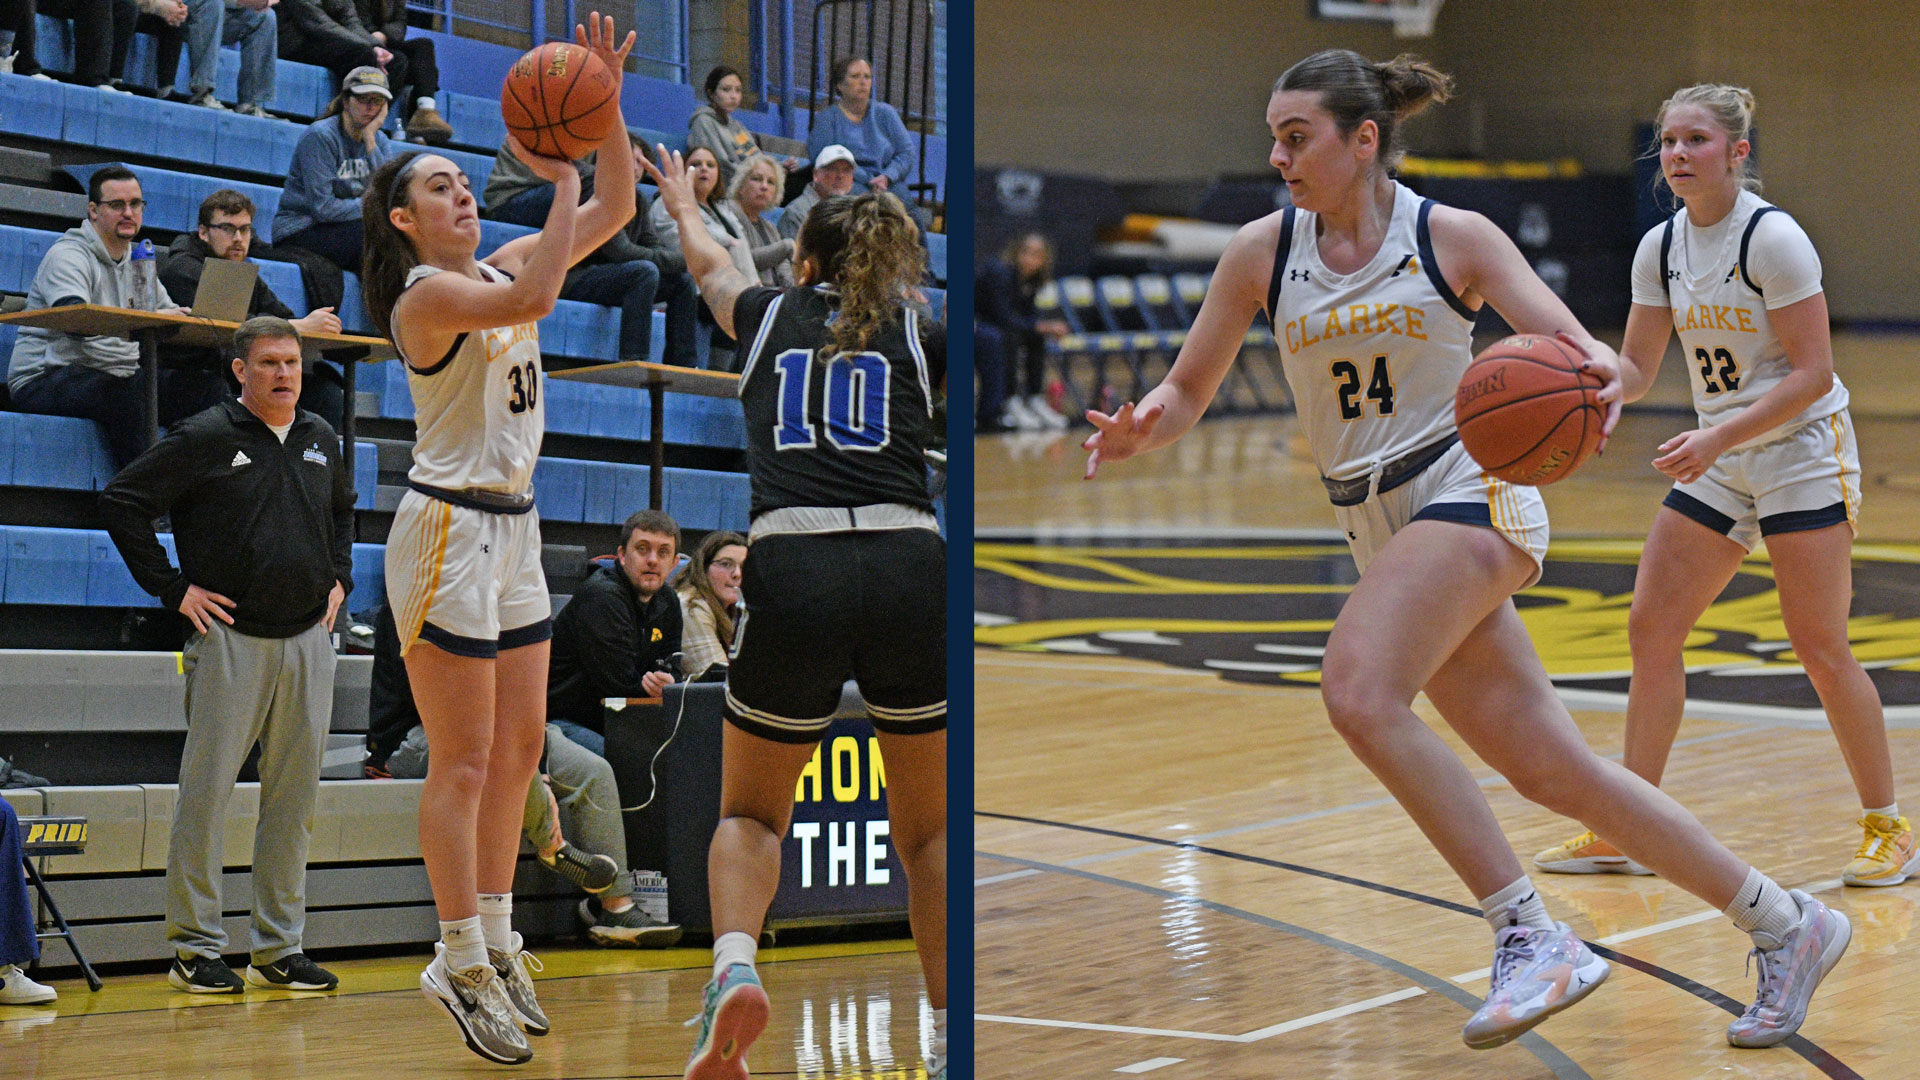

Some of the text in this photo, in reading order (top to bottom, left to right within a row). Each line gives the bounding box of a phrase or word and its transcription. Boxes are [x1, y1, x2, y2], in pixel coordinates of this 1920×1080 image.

[1285, 303, 1428, 355] CLARKE
[1671, 304, 1759, 334] LARKE
[506, 357, 537, 417] 30
[773, 348, 892, 453] 10
[1328, 352, 1397, 424] 24
[1694, 345, 1742, 396] 22
[792, 819, 890, 889] THE
